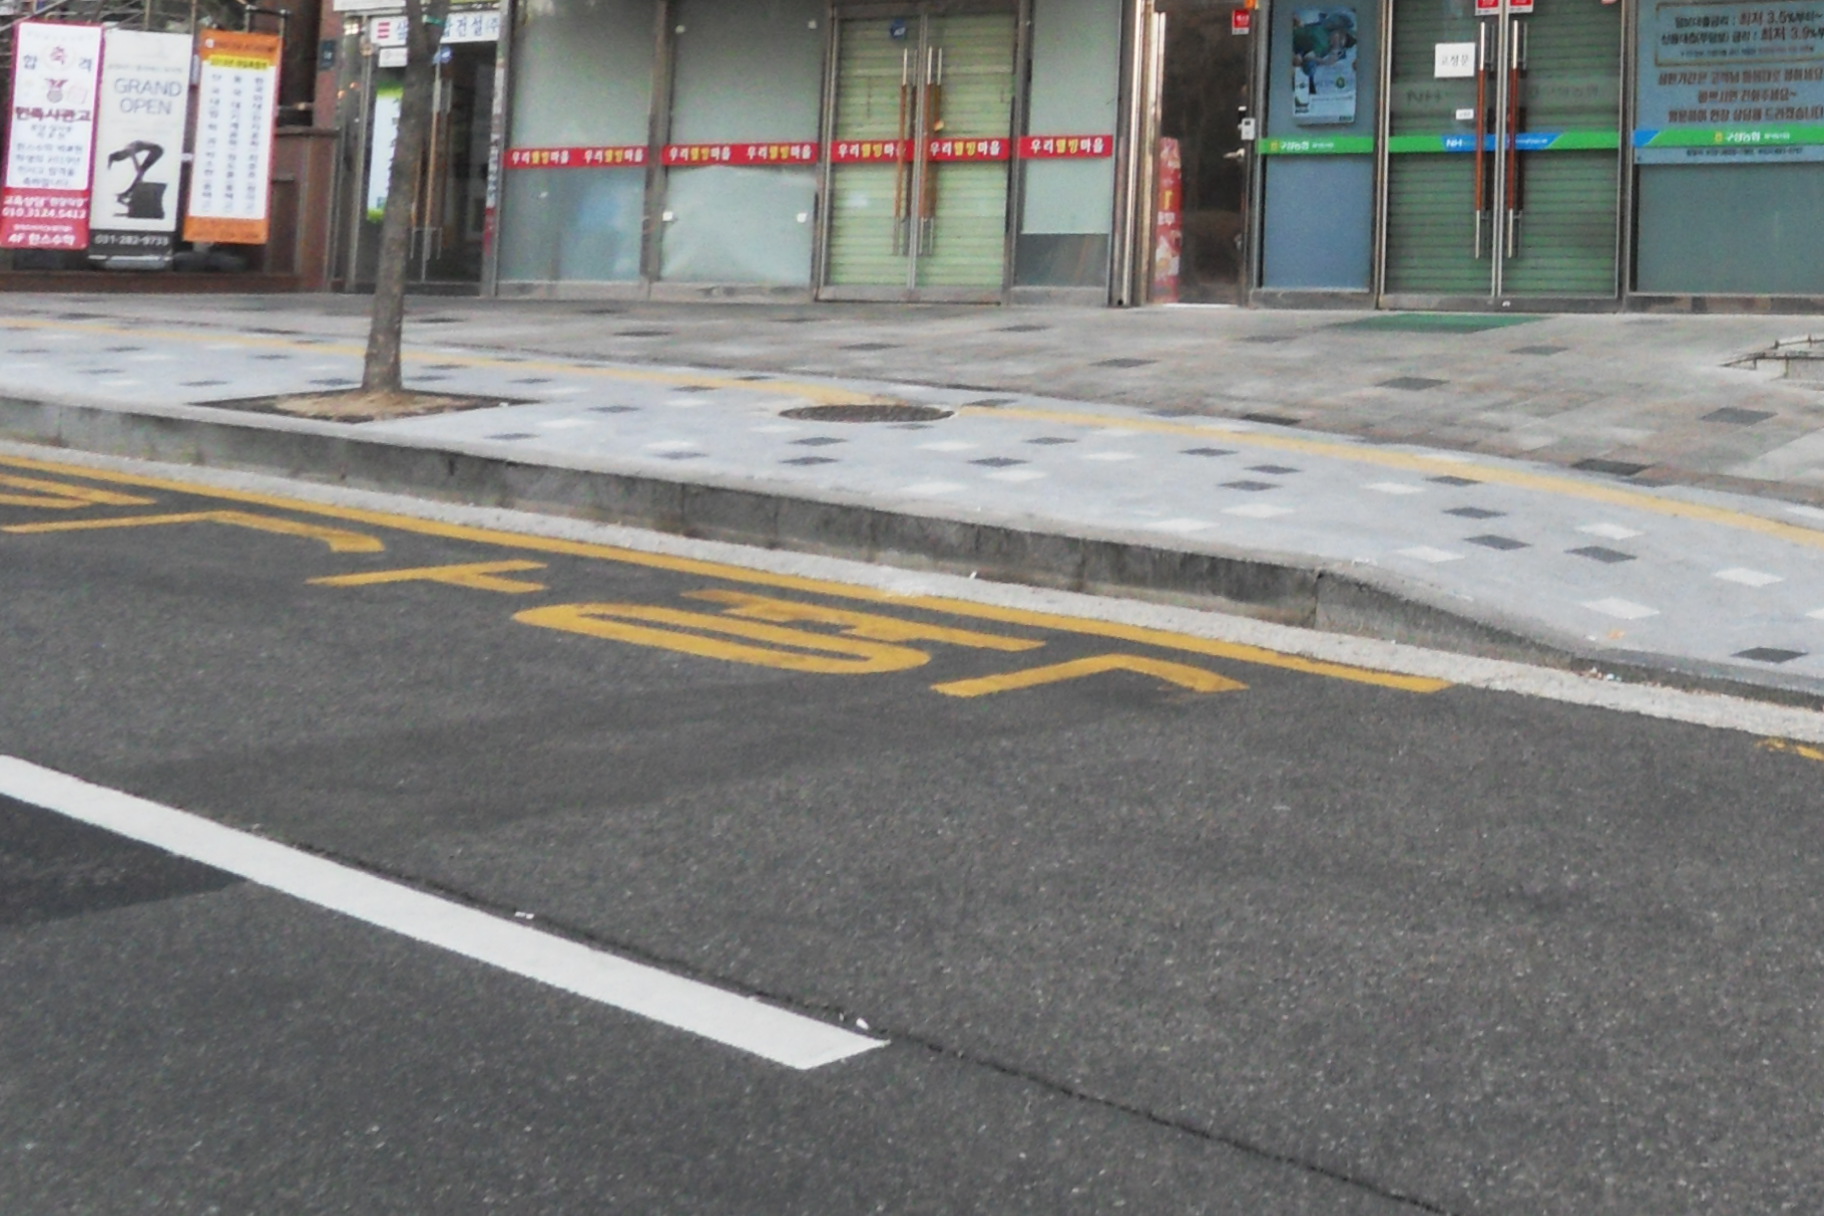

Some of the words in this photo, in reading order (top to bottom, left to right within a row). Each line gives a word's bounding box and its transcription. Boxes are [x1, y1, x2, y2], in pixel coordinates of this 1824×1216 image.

[115, 77, 183, 97] GRAND
[120, 98, 172, 115] OPEN
[929, 140, 1001, 158] 우리웰빙마을
[1030, 137, 1105, 155] 우리웰빙마을
